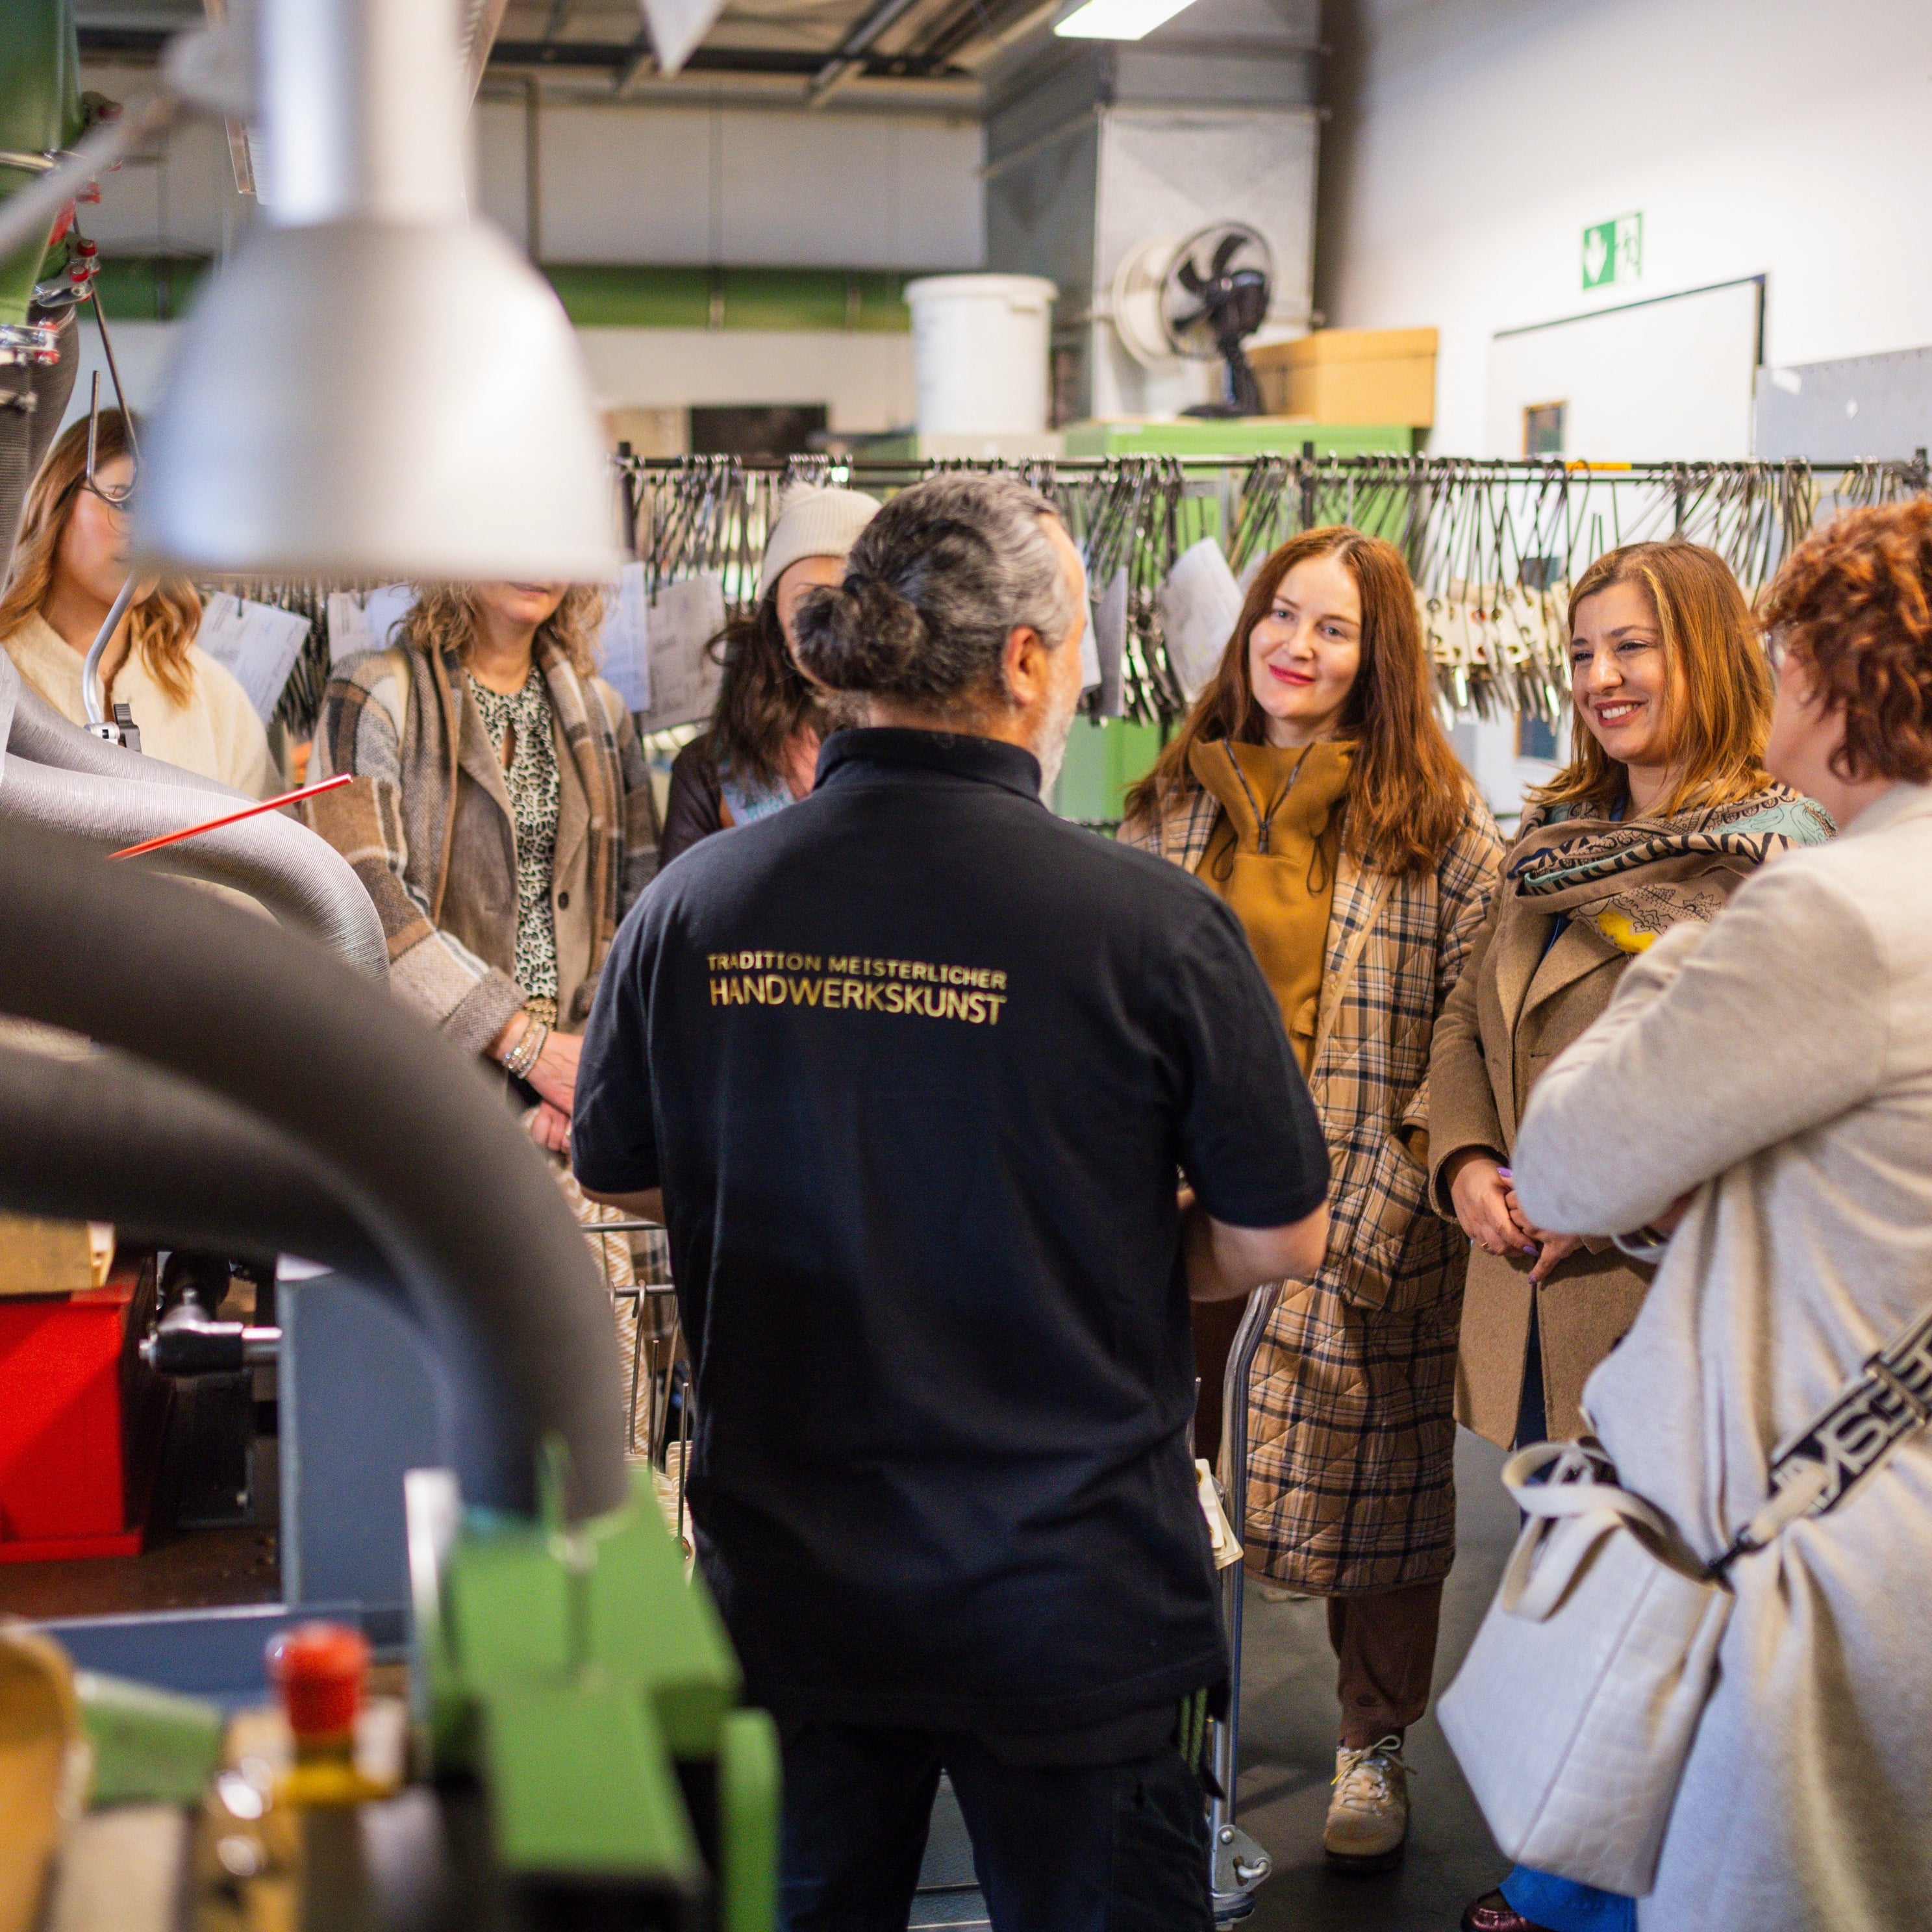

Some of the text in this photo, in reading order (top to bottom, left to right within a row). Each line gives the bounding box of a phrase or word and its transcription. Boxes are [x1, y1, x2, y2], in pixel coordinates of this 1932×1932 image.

[707, 950, 1007, 990] TRADITION MEISTERLICHER
[709, 973, 1008, 1026] HANDWERKSKUNST
